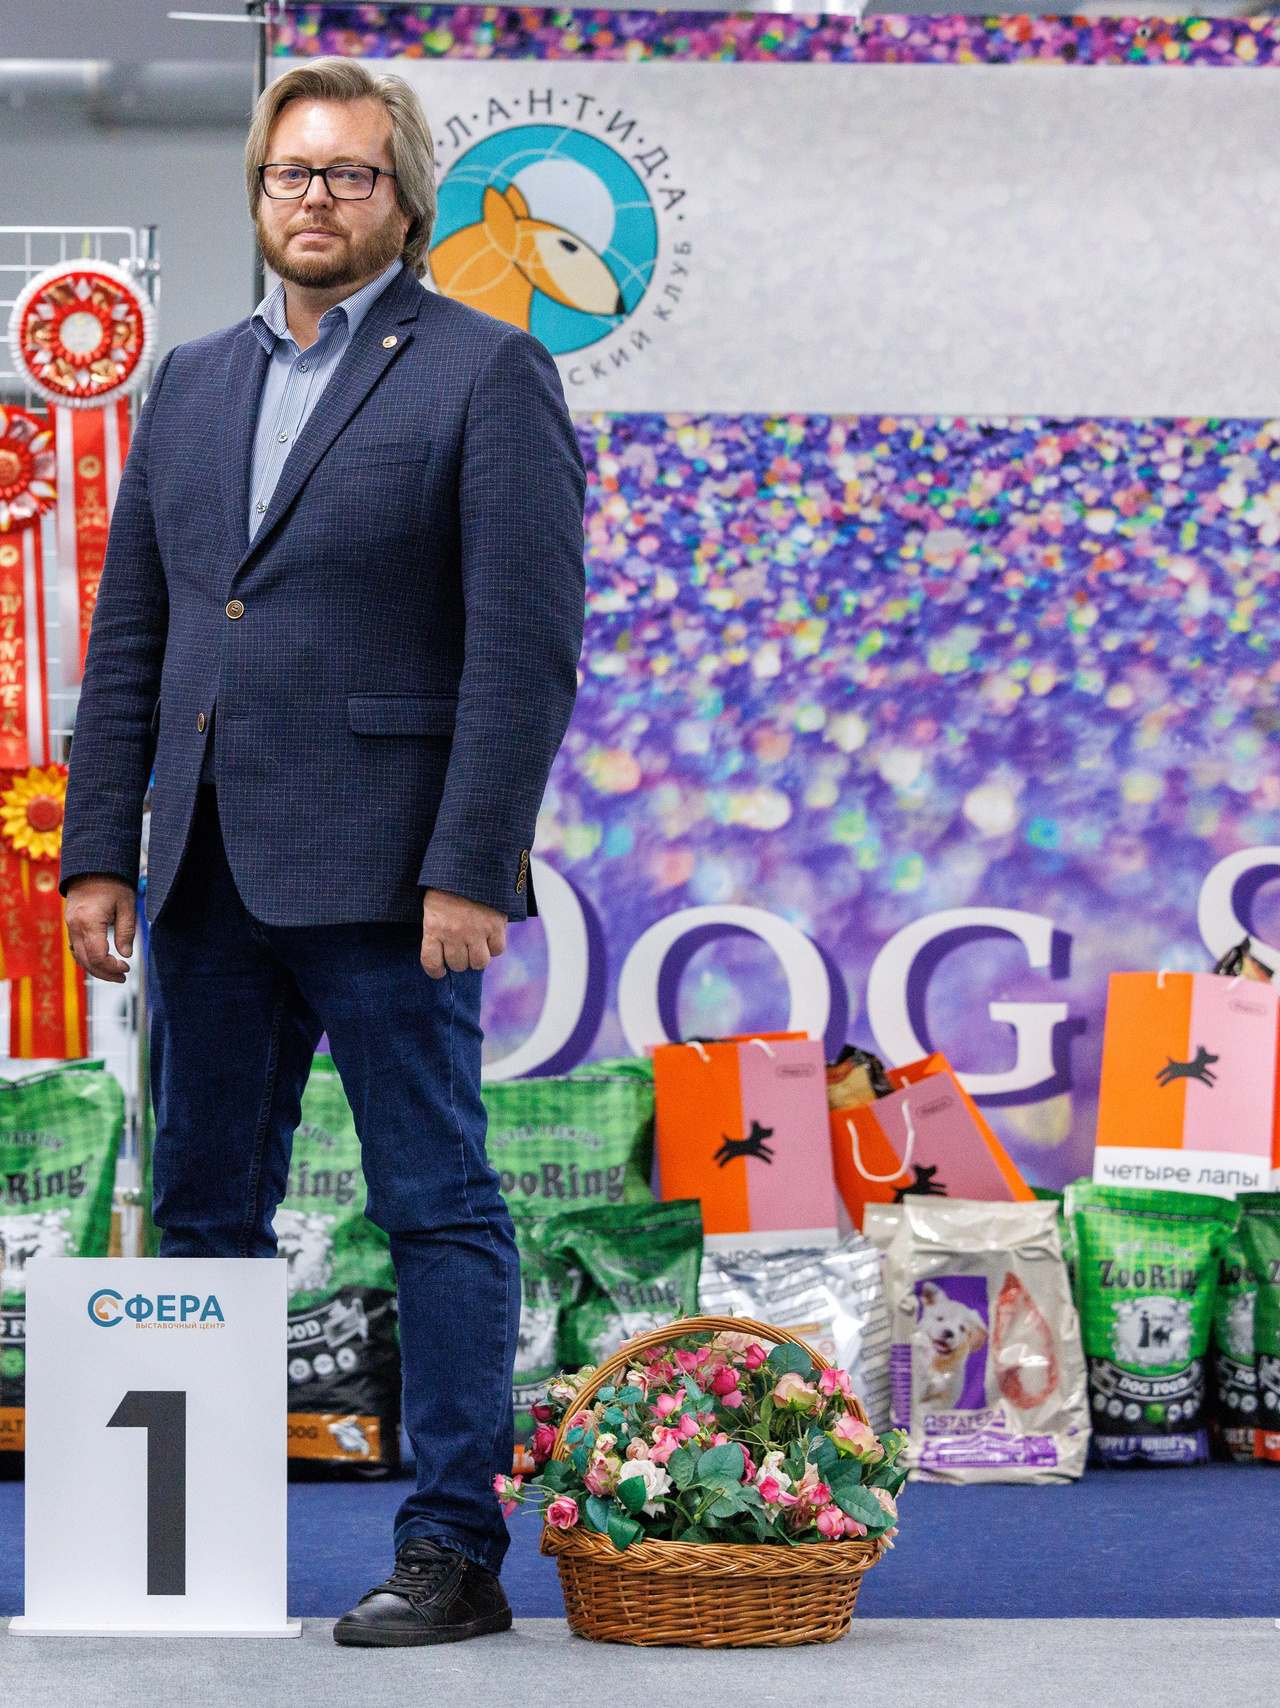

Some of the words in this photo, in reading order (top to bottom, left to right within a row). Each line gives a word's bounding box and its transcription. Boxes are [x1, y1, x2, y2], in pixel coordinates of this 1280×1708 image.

[568, 329, 651, 386] СКИЙ
[653, 240, 692, 322] КЛУБ
[500, 1163, 626, 1203] ooRing
[1103, 1163, 1191, 1183] четыре
[1197, 1168, 1260, 1187] лапы
[87, 1288, 226, 1328] СФЕРА
[135, 1321, 197, 1329] ВЫСТАВОЧНЫЙ
[106, 1391, 186, 1595] 1
